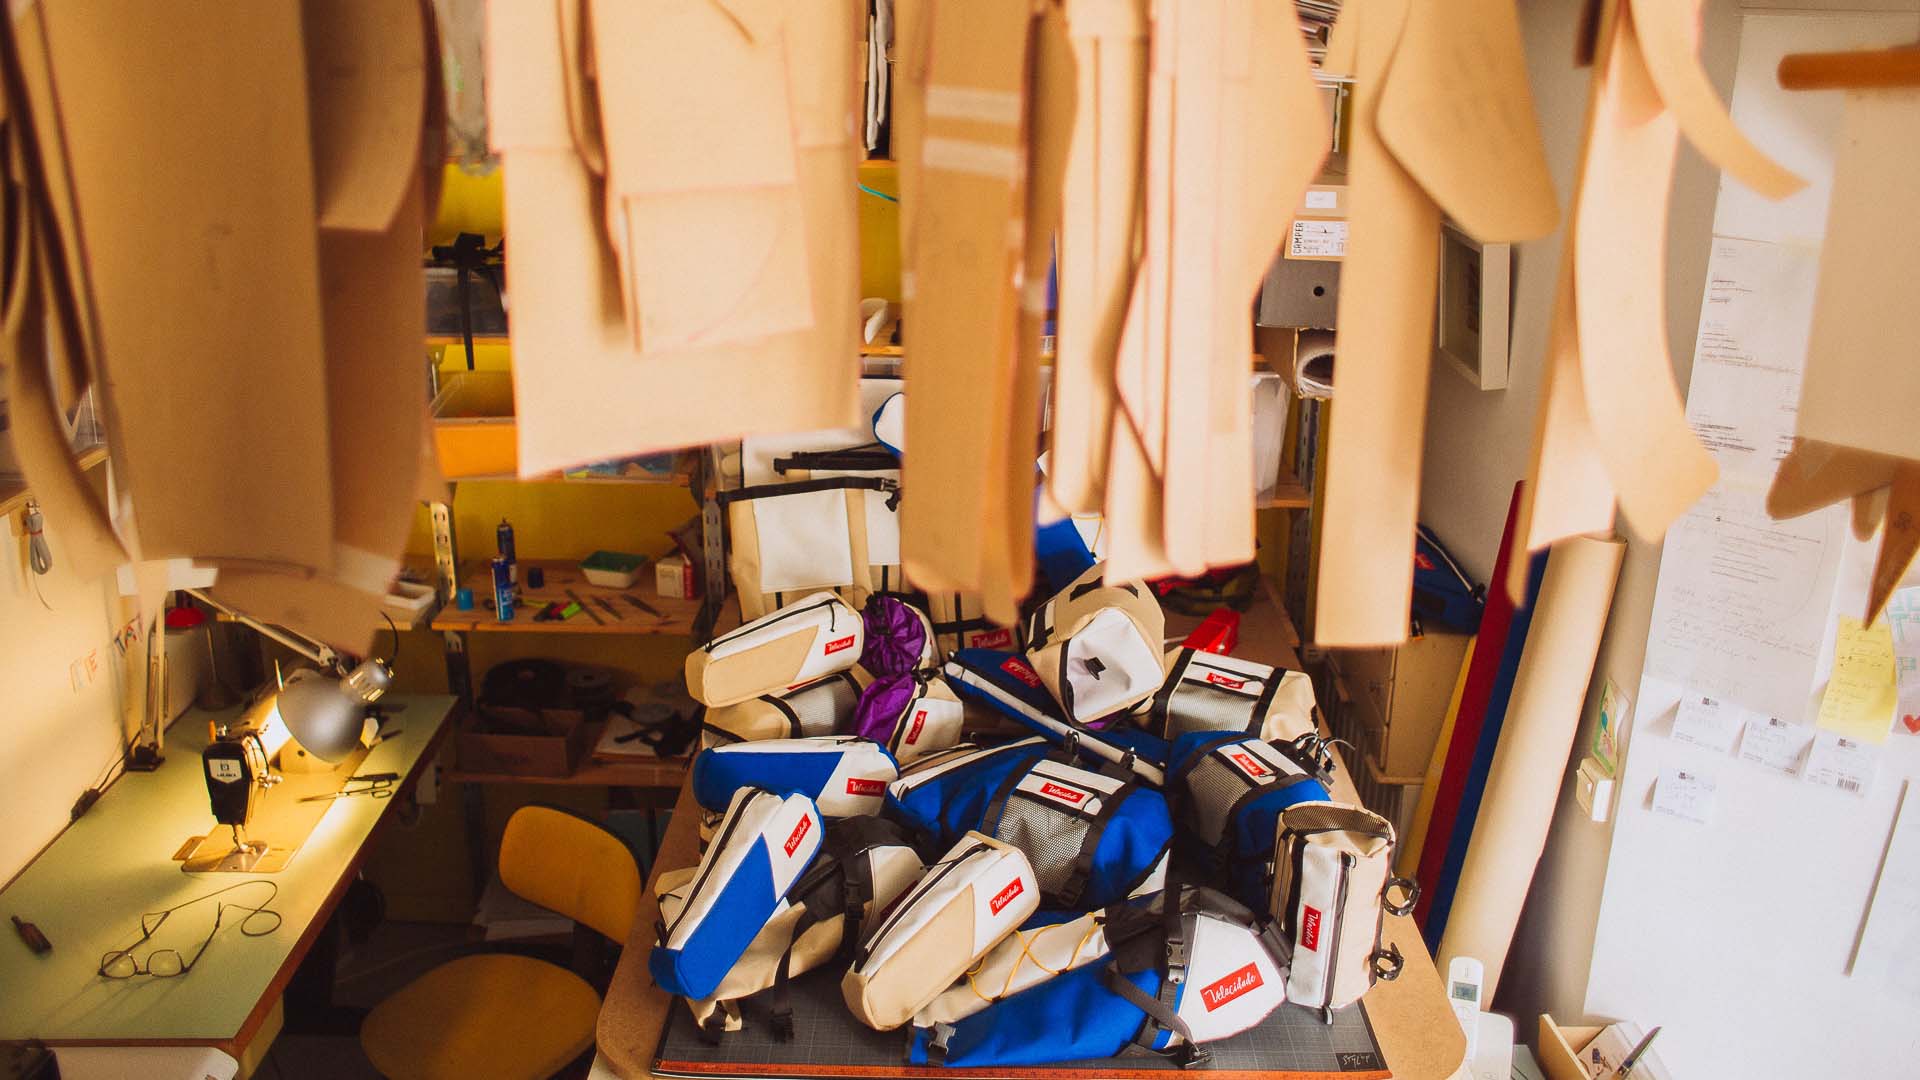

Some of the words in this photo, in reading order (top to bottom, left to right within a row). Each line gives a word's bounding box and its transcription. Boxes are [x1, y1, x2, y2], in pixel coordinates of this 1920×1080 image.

[1293, 222, 1304, 254] CAMPER
[1048, 784, 1078, 800] Velocidade
[786, 820, 808, 851] Velocidade
[992, 884, 1020, 909] Velocidade
[1204, 971, 1257, 1003] Velocidade
